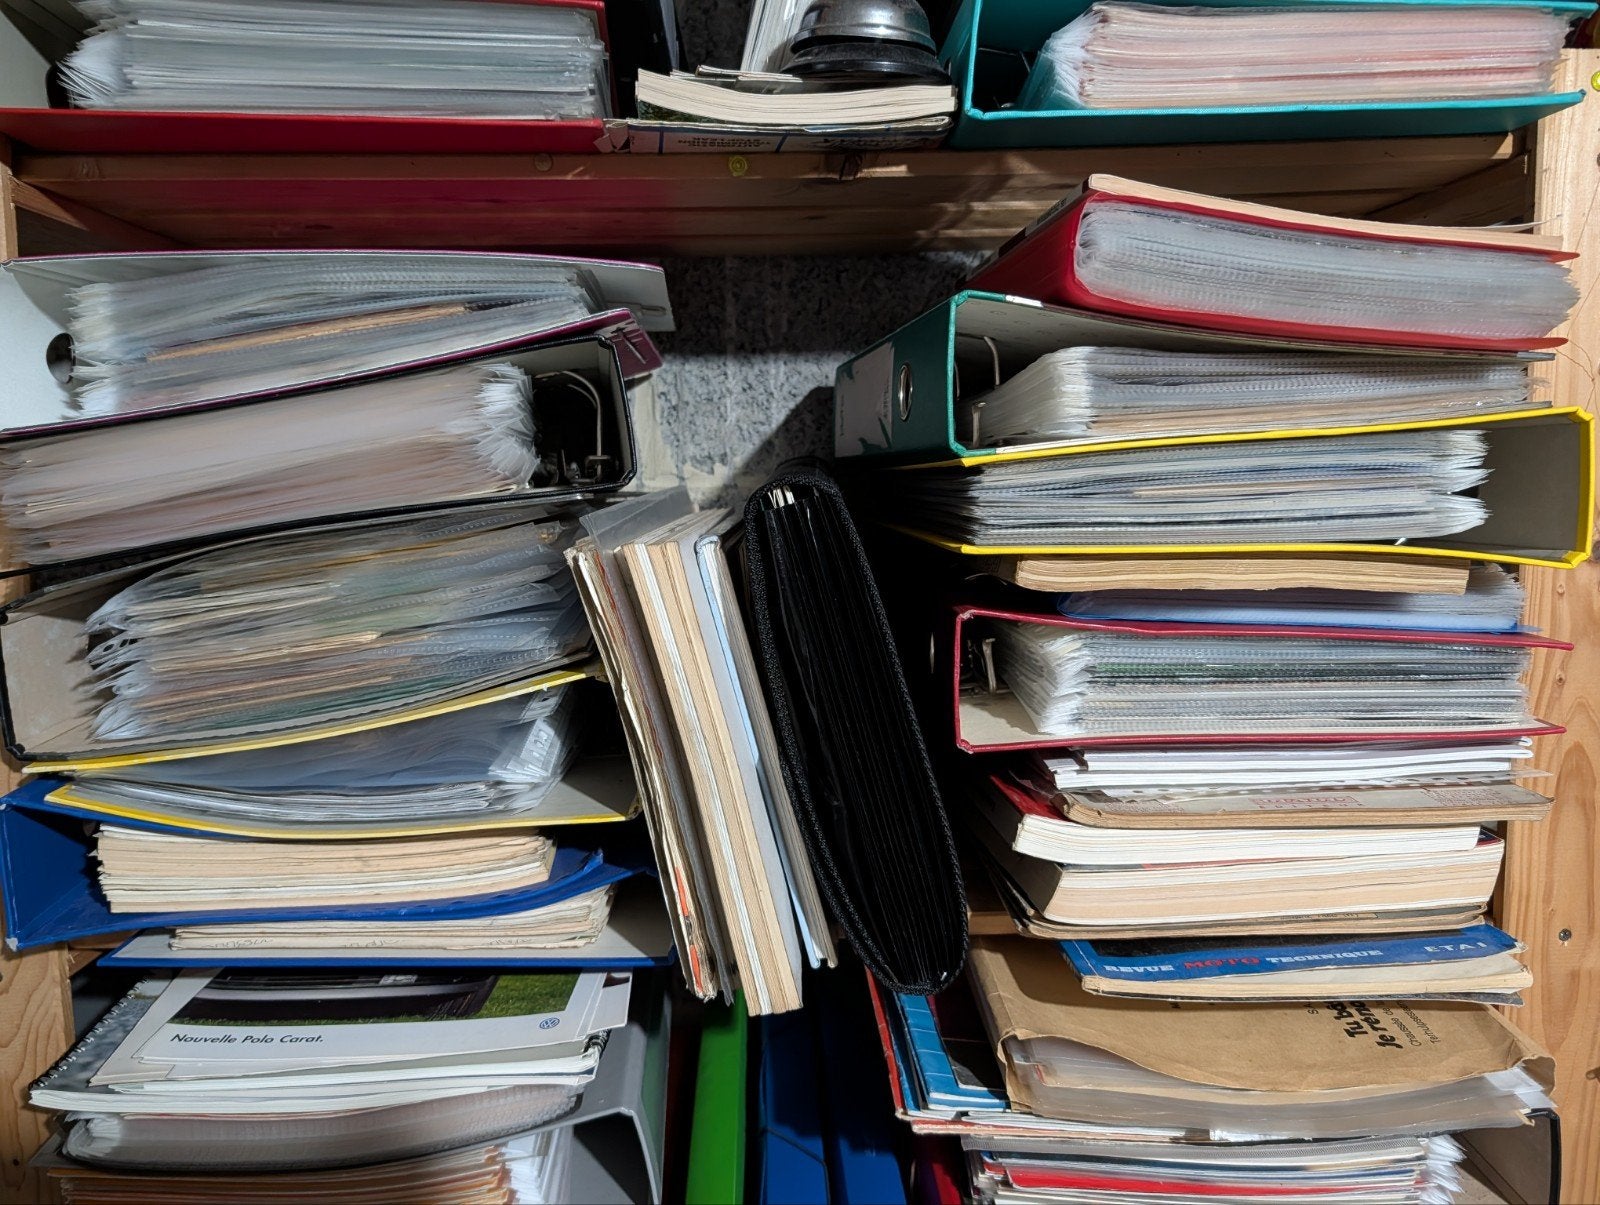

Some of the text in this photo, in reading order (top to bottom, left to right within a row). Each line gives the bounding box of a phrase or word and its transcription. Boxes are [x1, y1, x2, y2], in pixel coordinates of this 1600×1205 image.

[1103, 949, 1384, 973] REVUE MOTO TECHNIQUE
[1324, 1000, 1368, 1038] Tu bâ
[170, 1033, 324, 1043] Nouvelle Polo Carat.
[1375, 1033, 1403, 1049] Je
